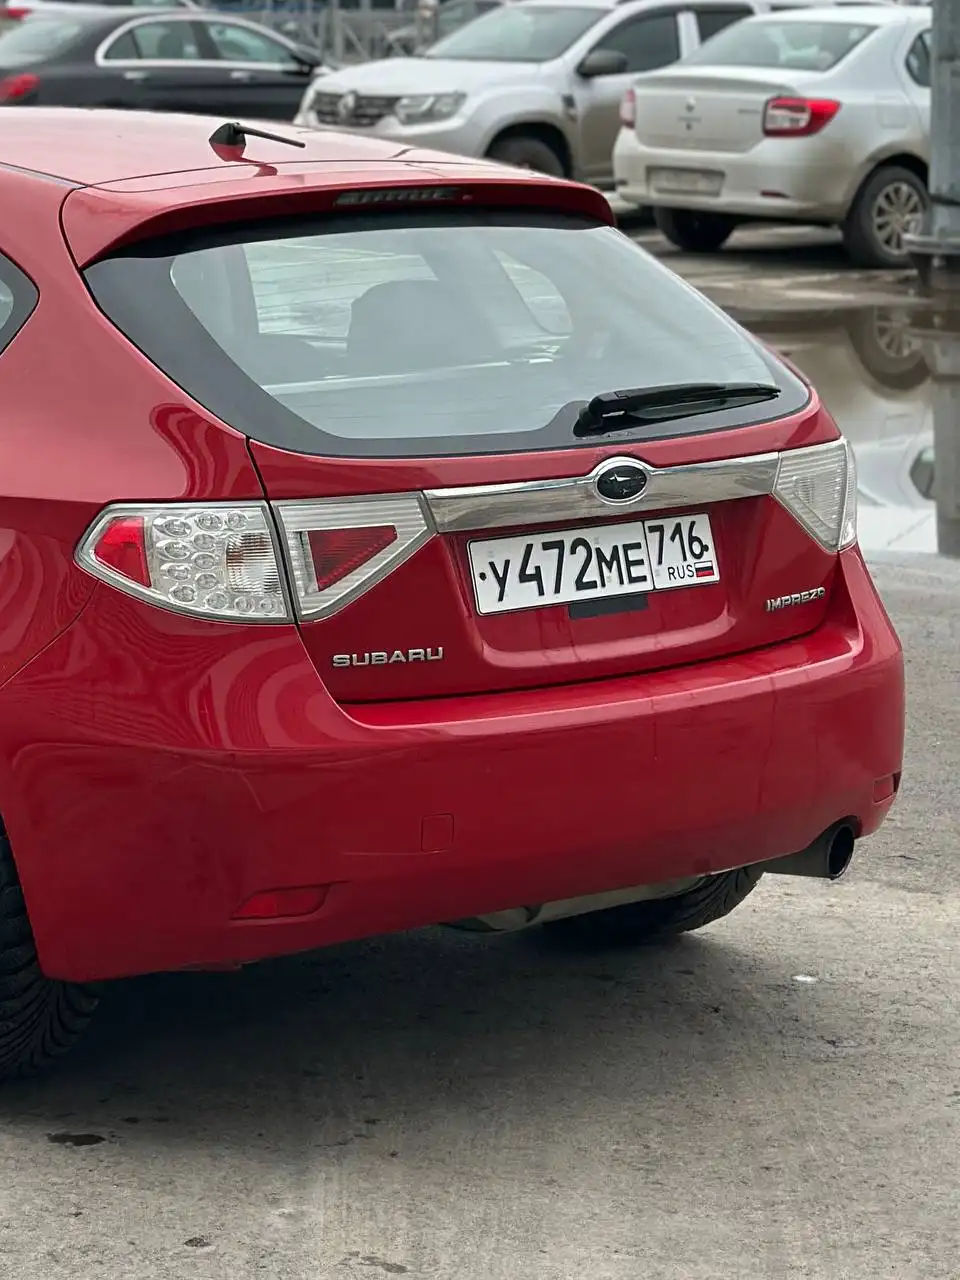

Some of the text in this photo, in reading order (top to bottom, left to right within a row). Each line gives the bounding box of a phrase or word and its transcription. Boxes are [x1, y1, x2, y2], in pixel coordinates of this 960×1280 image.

[648, 520, 703, 565] 716
[667, 565, 695, 581] RUS
[332, 646, 443, 667] SUBARU
